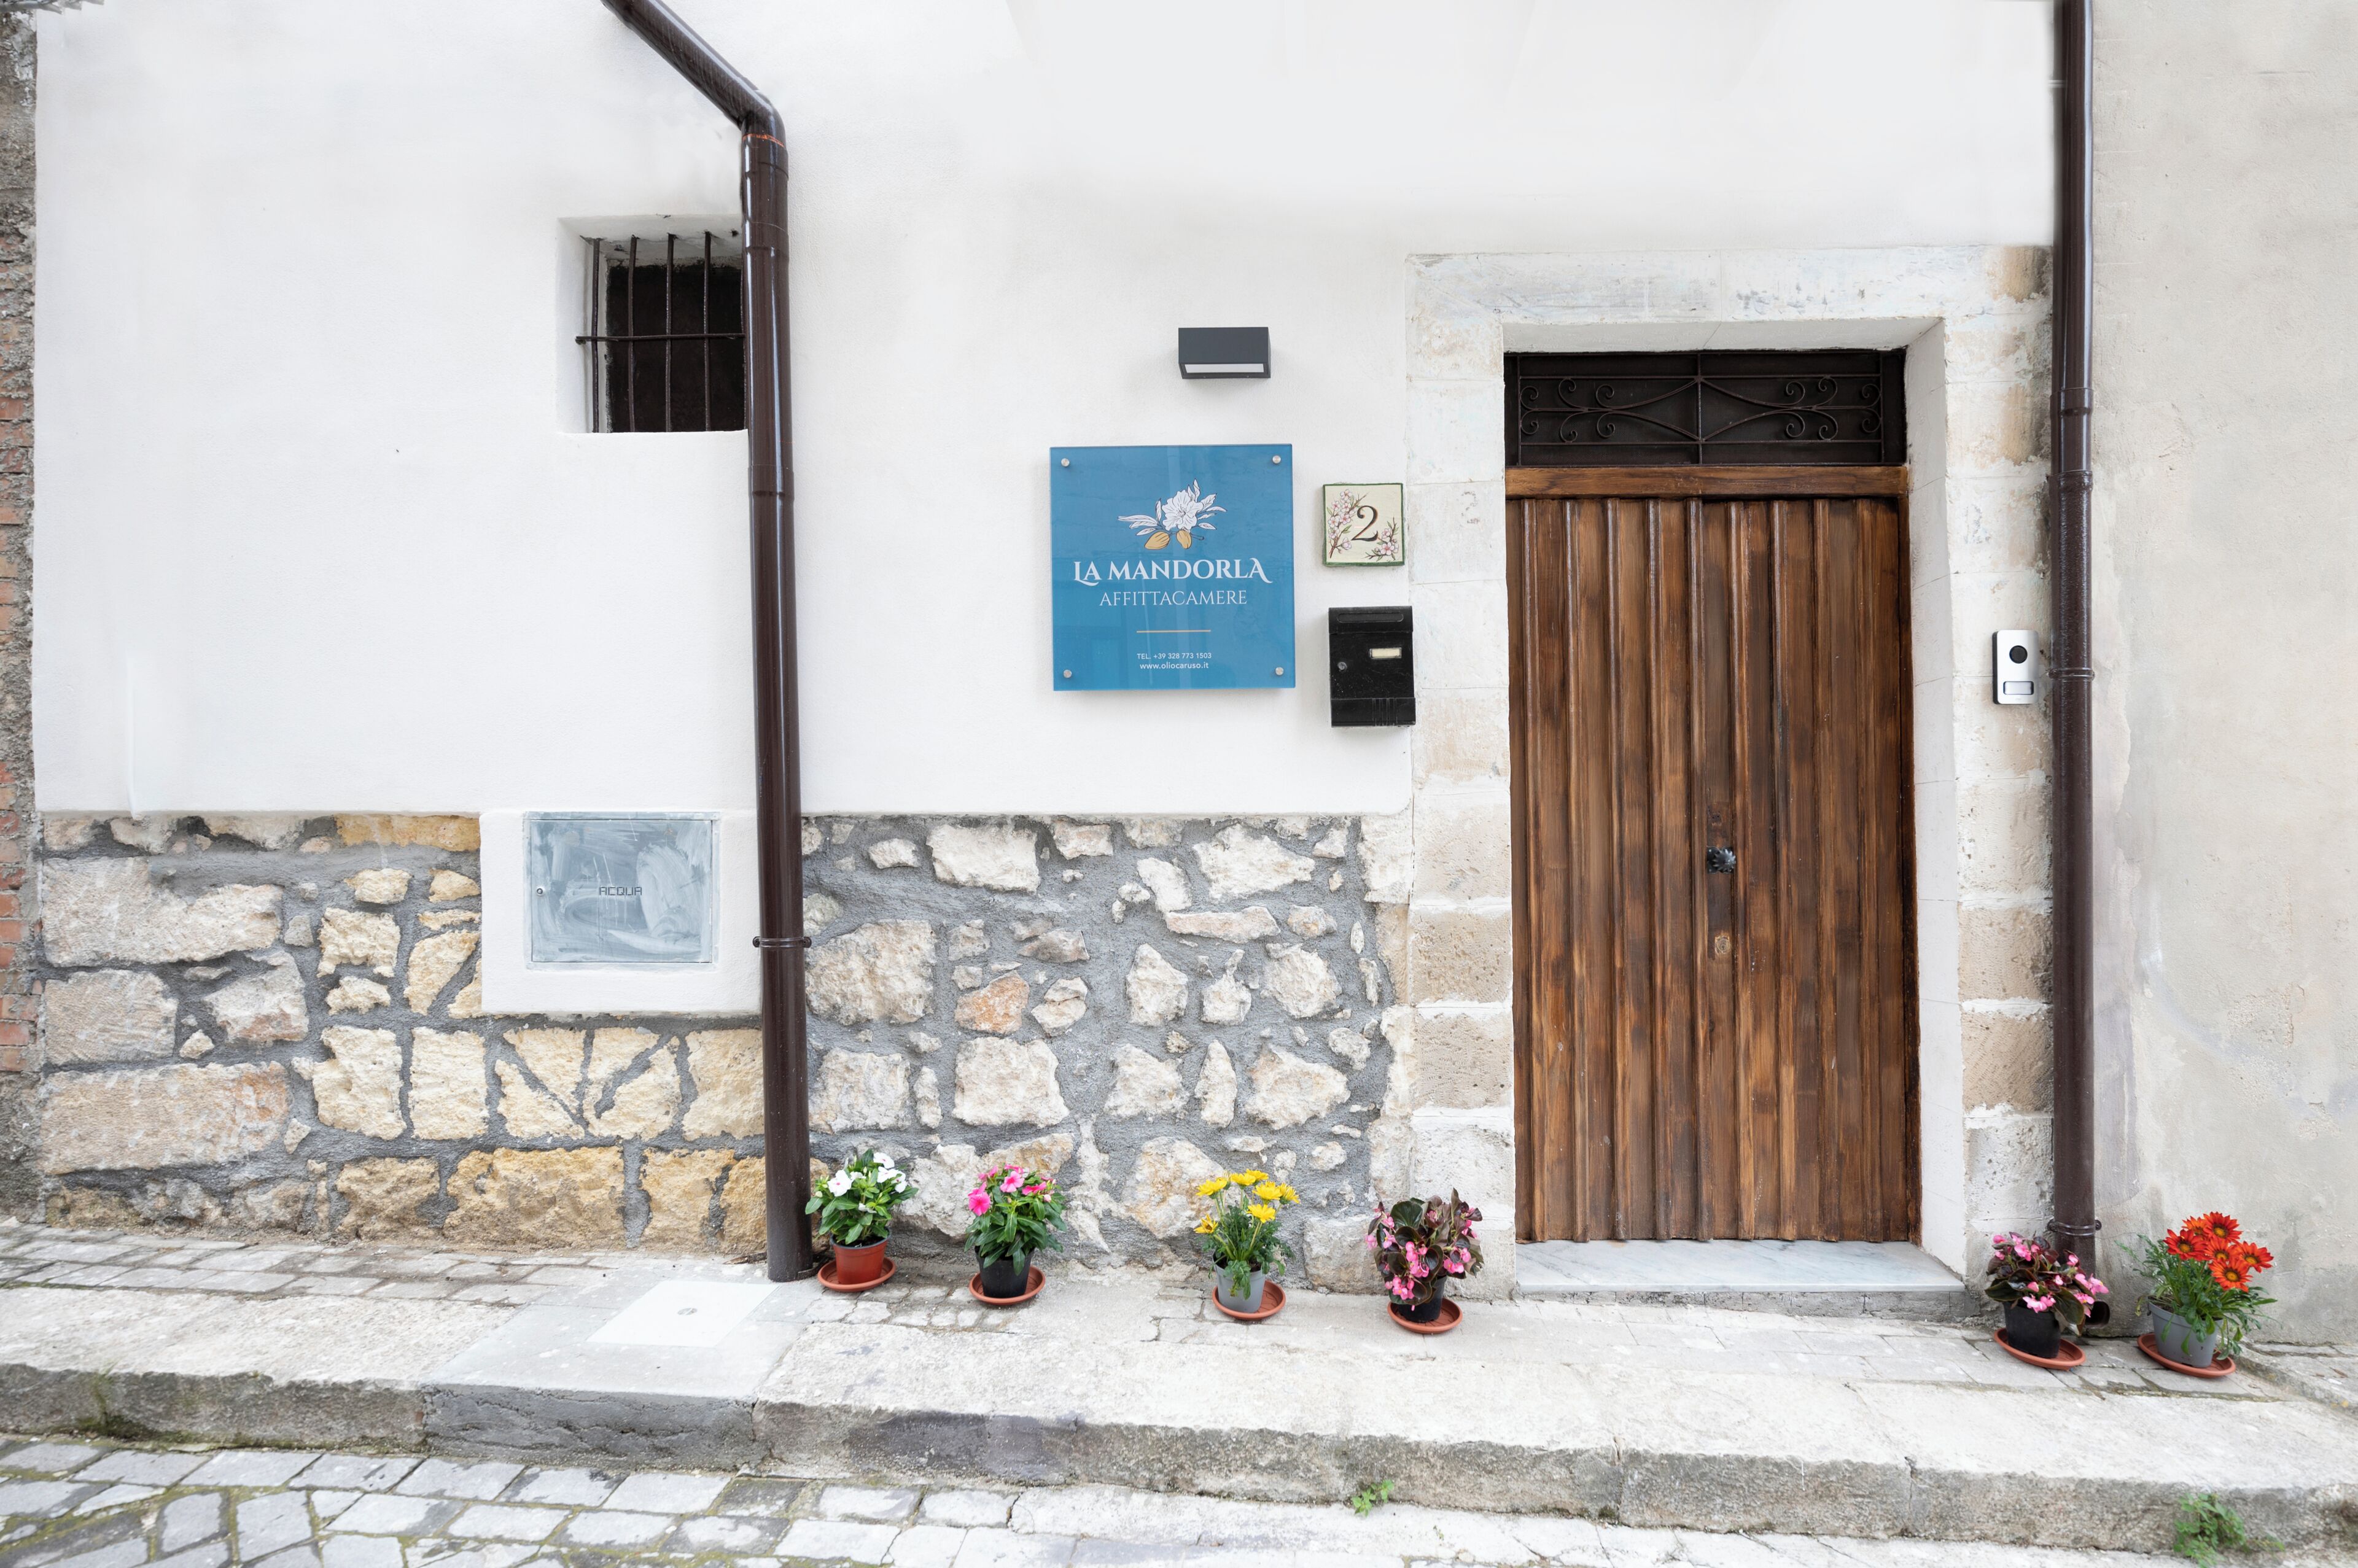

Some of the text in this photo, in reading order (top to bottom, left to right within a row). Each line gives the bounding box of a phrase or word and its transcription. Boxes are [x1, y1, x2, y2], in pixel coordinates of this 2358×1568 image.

[1352, 505, 1378, 541] 2
[1073, 557, 1273, 586] LA MANDORLA
[1099, 590, 1248, 607] AFFITTACAMERE
[599, 887, 642, 896] ACQUA
